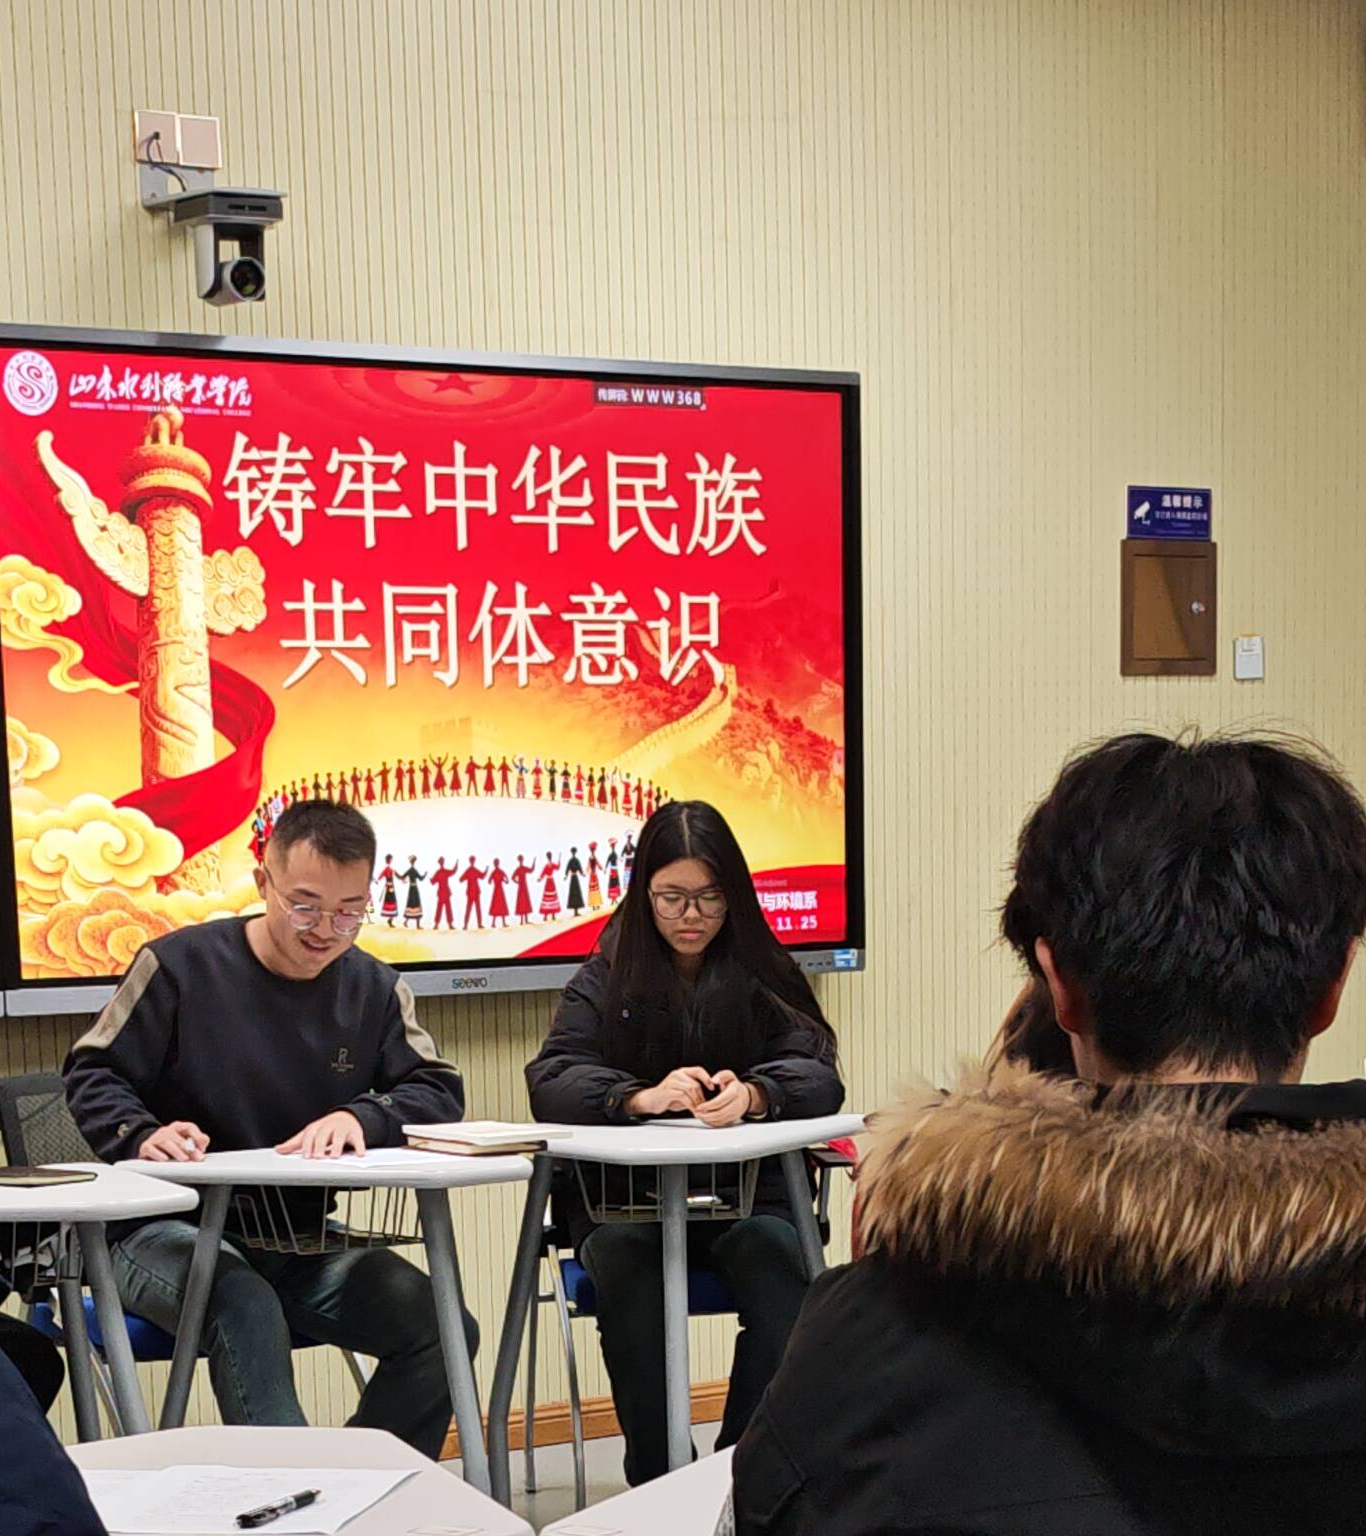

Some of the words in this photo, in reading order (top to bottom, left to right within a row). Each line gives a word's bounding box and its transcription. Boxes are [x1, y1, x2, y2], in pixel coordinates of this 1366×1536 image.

[222, 431, 767, 556] 铸牢中华民族
[280, 578, 723, 690] 共同体意识
